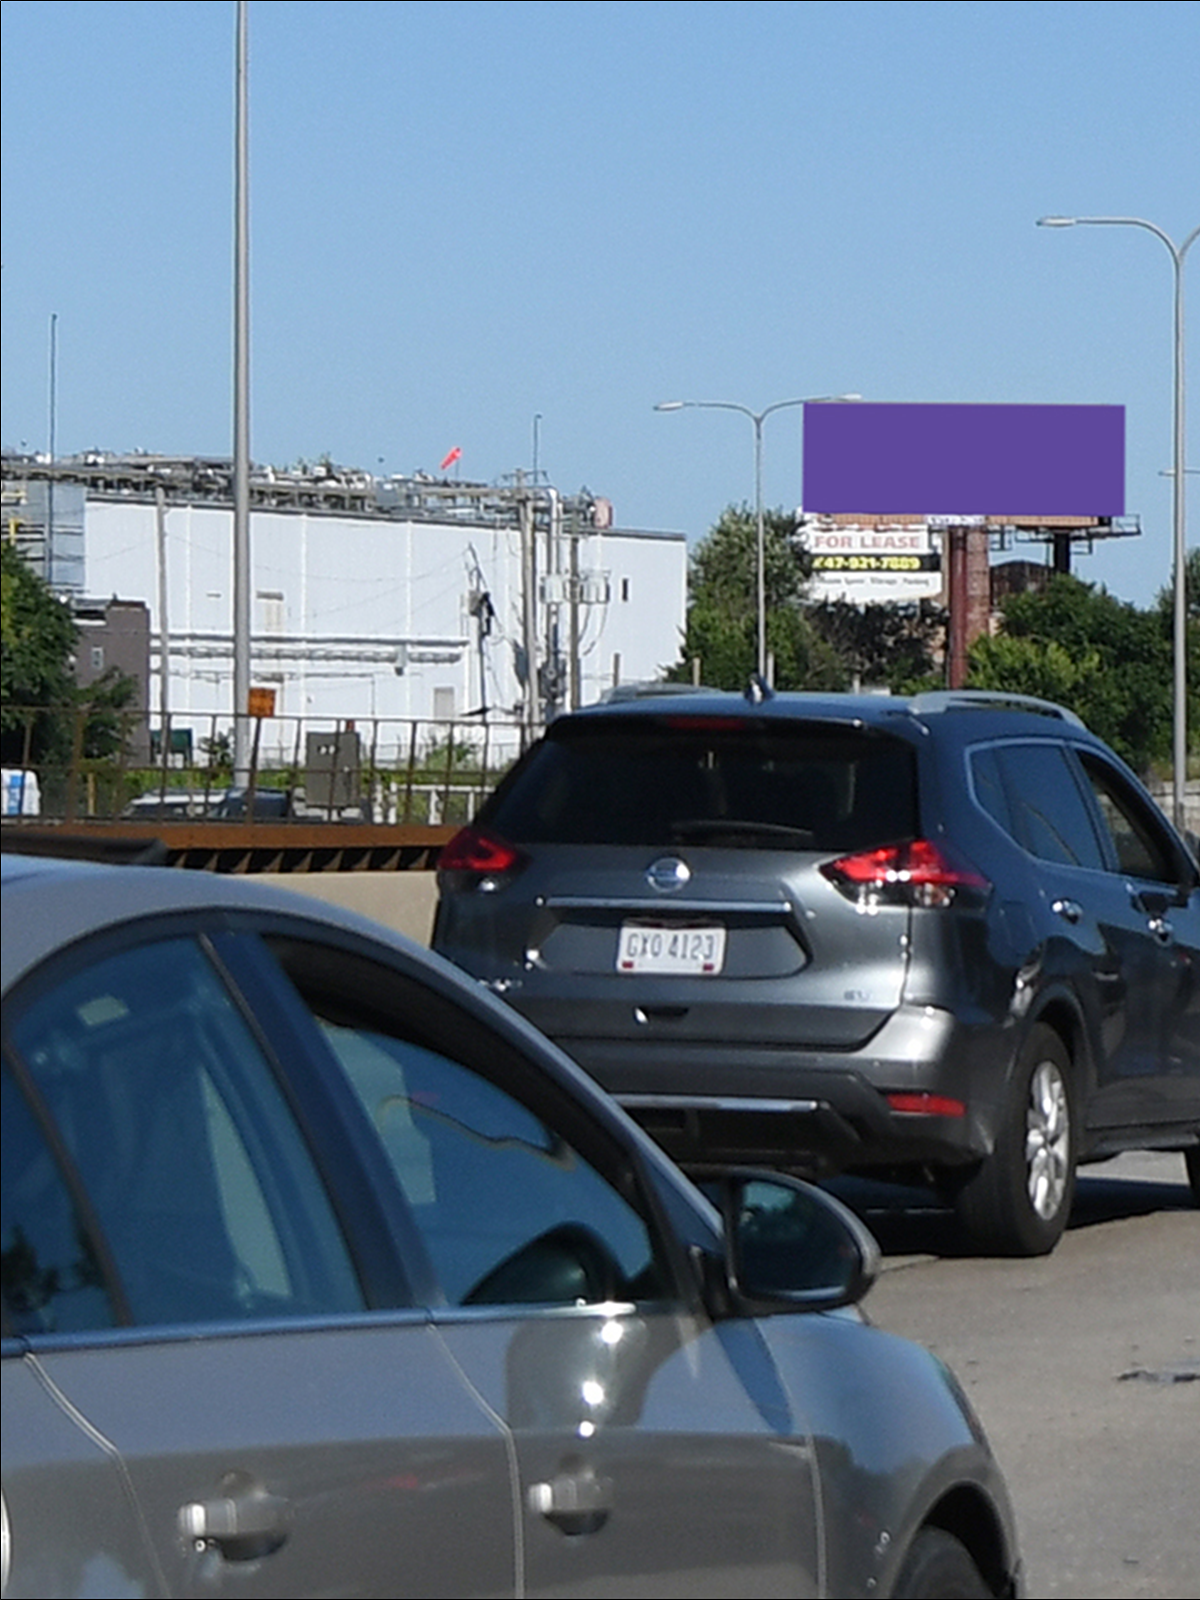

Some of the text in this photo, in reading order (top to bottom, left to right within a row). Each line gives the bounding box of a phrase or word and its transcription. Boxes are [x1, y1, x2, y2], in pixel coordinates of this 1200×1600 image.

[814, 535, 920, 549] FOR LEASE
[668, 934, 715, 960] 4123
